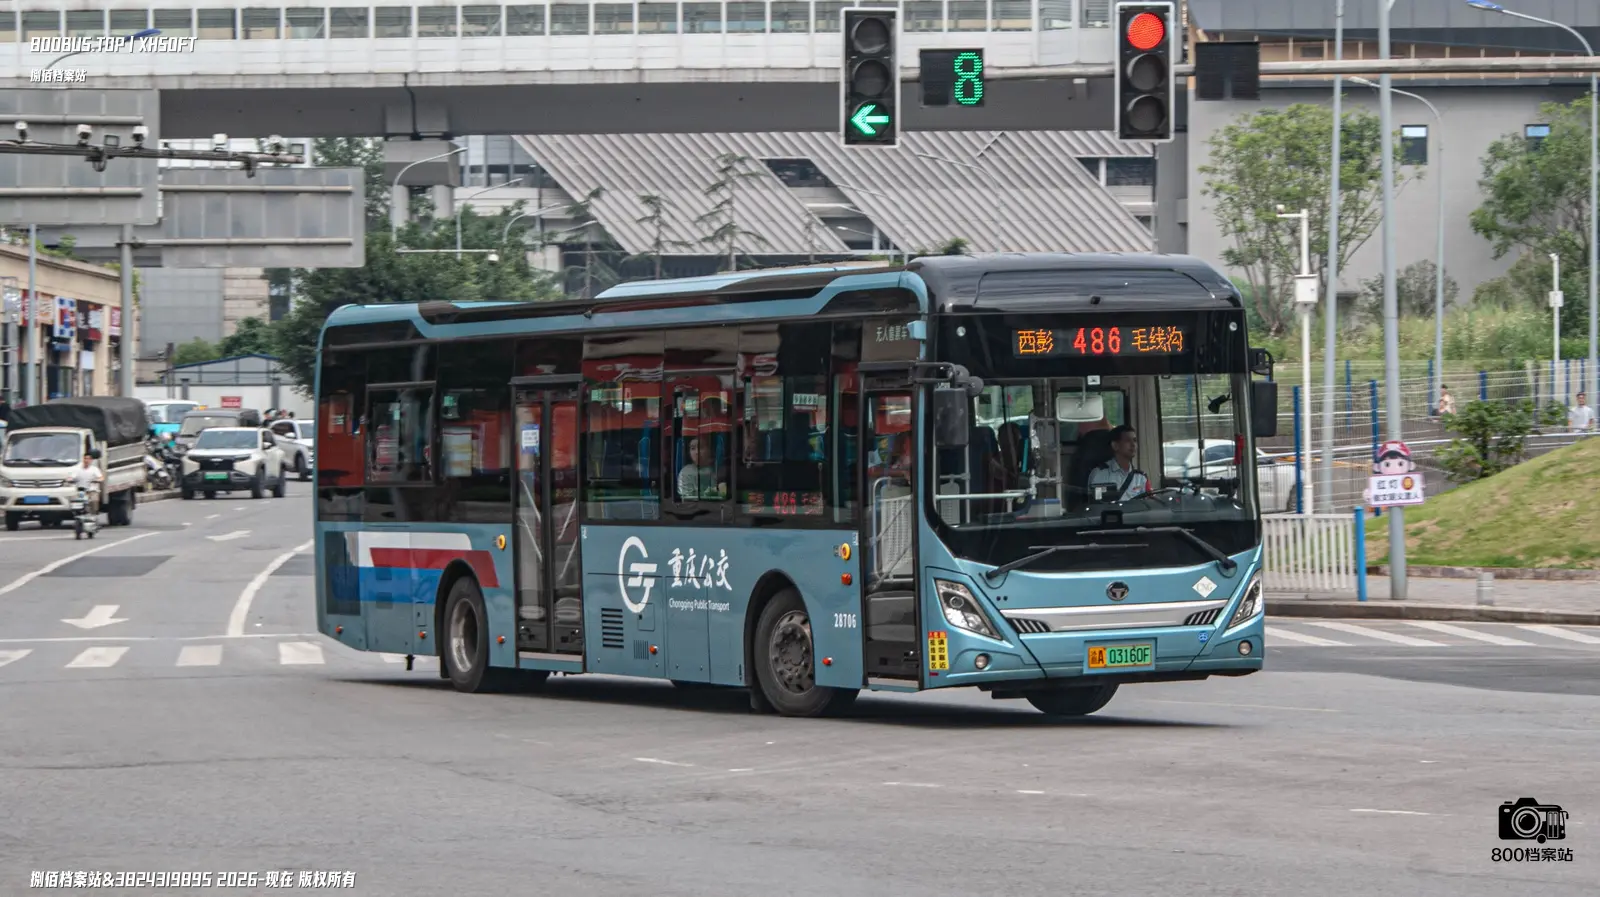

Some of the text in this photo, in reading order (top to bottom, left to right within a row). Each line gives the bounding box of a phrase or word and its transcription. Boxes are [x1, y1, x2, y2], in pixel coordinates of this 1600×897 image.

[954, 52, 983, 105] 8
[1018, 326, 1183, 355] 西彭 486 毛线沟
[667, 547, 733, 591] 重庆公交
[669, 597, 730, 613] Chongqing Public Transport
[834, 612, 857, 628] 28706
[1109, 647, 1150, 664] 03160F
